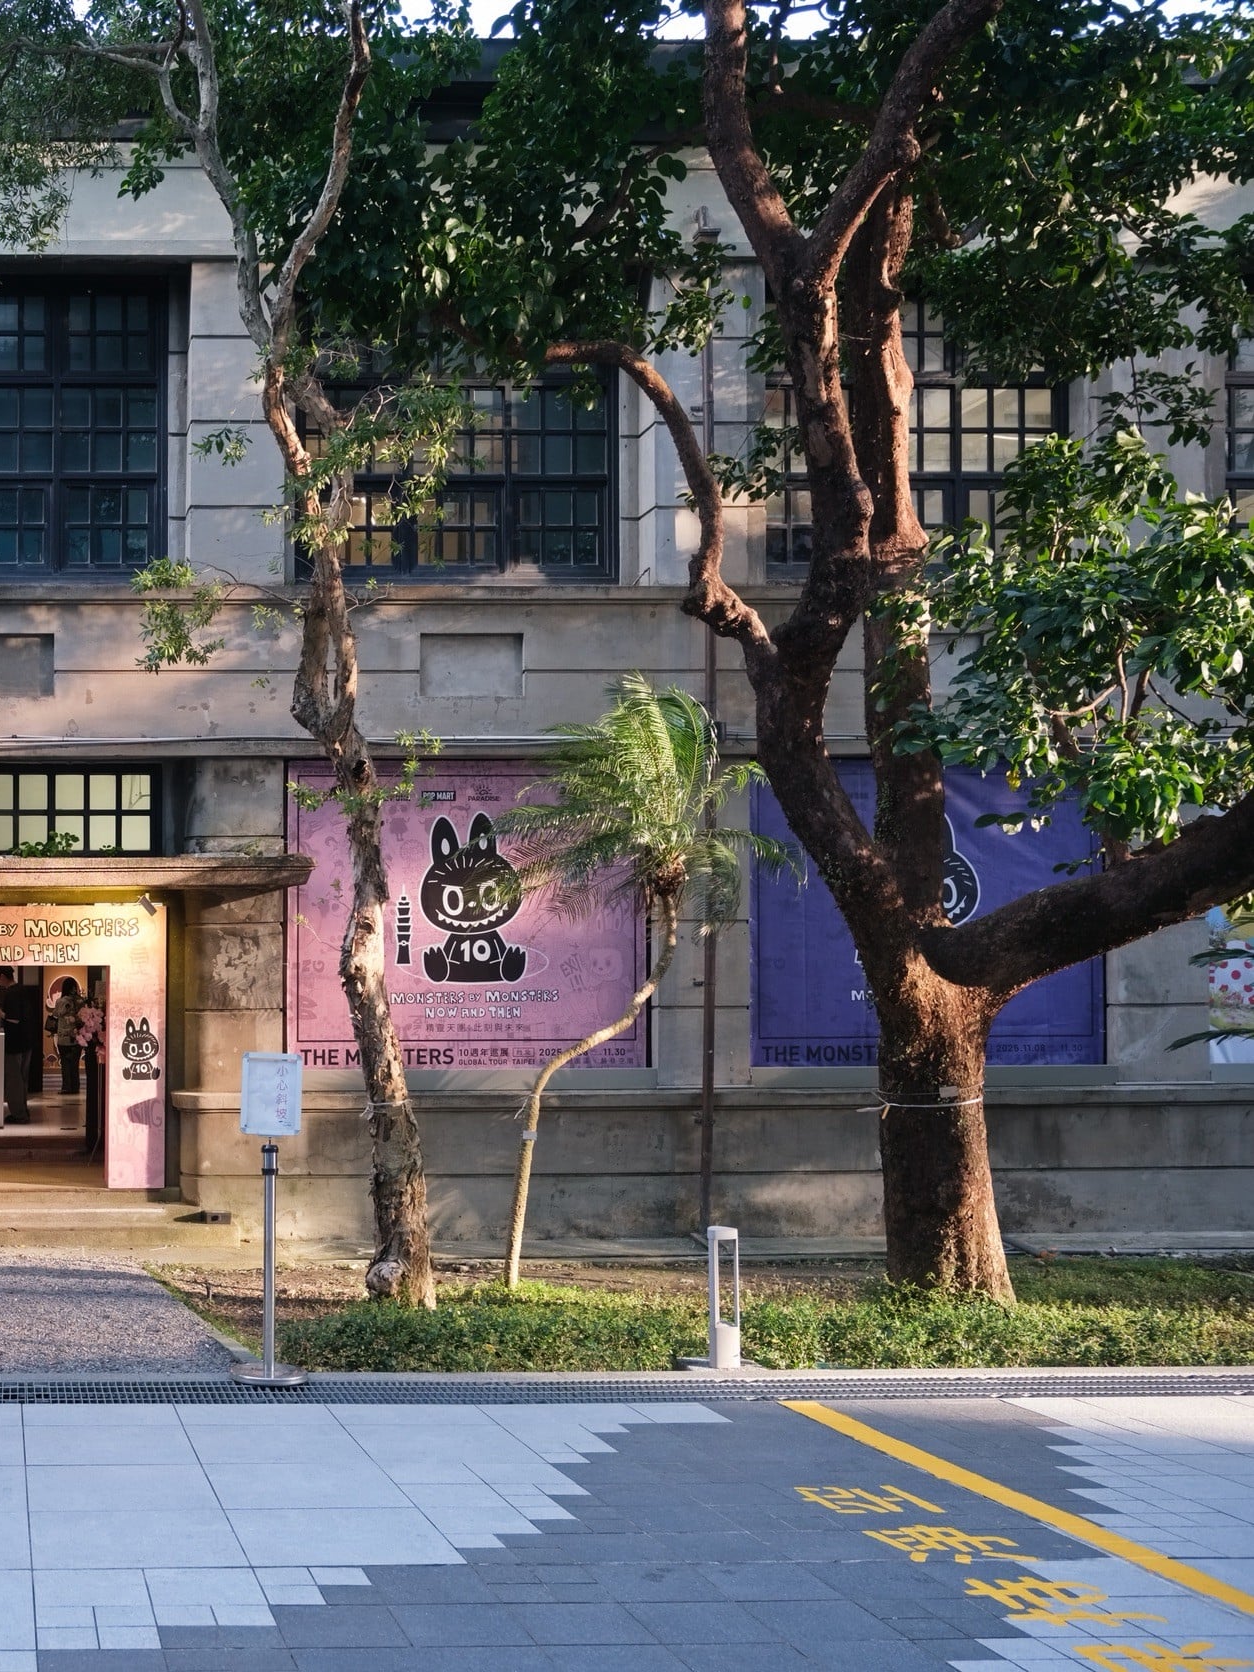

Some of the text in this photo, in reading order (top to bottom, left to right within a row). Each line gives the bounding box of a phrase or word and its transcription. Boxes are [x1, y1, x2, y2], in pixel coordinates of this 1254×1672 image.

[436, 791, 455, 801] MART
[24, 917, 141, 938] MONSTERS
[28, 943, 80, 963] THEN
[460, 940, 491, 963] 10
[391, 990, 560, 1004] MONSTERS BY MONSTERS
[425, 1006, 522, 1019] NOW AND THEN
[458, 1048, 509, 1057] 10週年巡展
[603, 1048, 626, 1056] 11.30
[762, 1046, 800, 1063] THE
[996, 1044, 1083, 1053] 2025.11.08 11.30
[300, 1048, 454, 1066] THE MTERS
[458, 1058, 487, 1066] GLOBAL
[135, 1064, 148, 1073] 10
[276, 1065, 289, 1120] 小心斜坡
